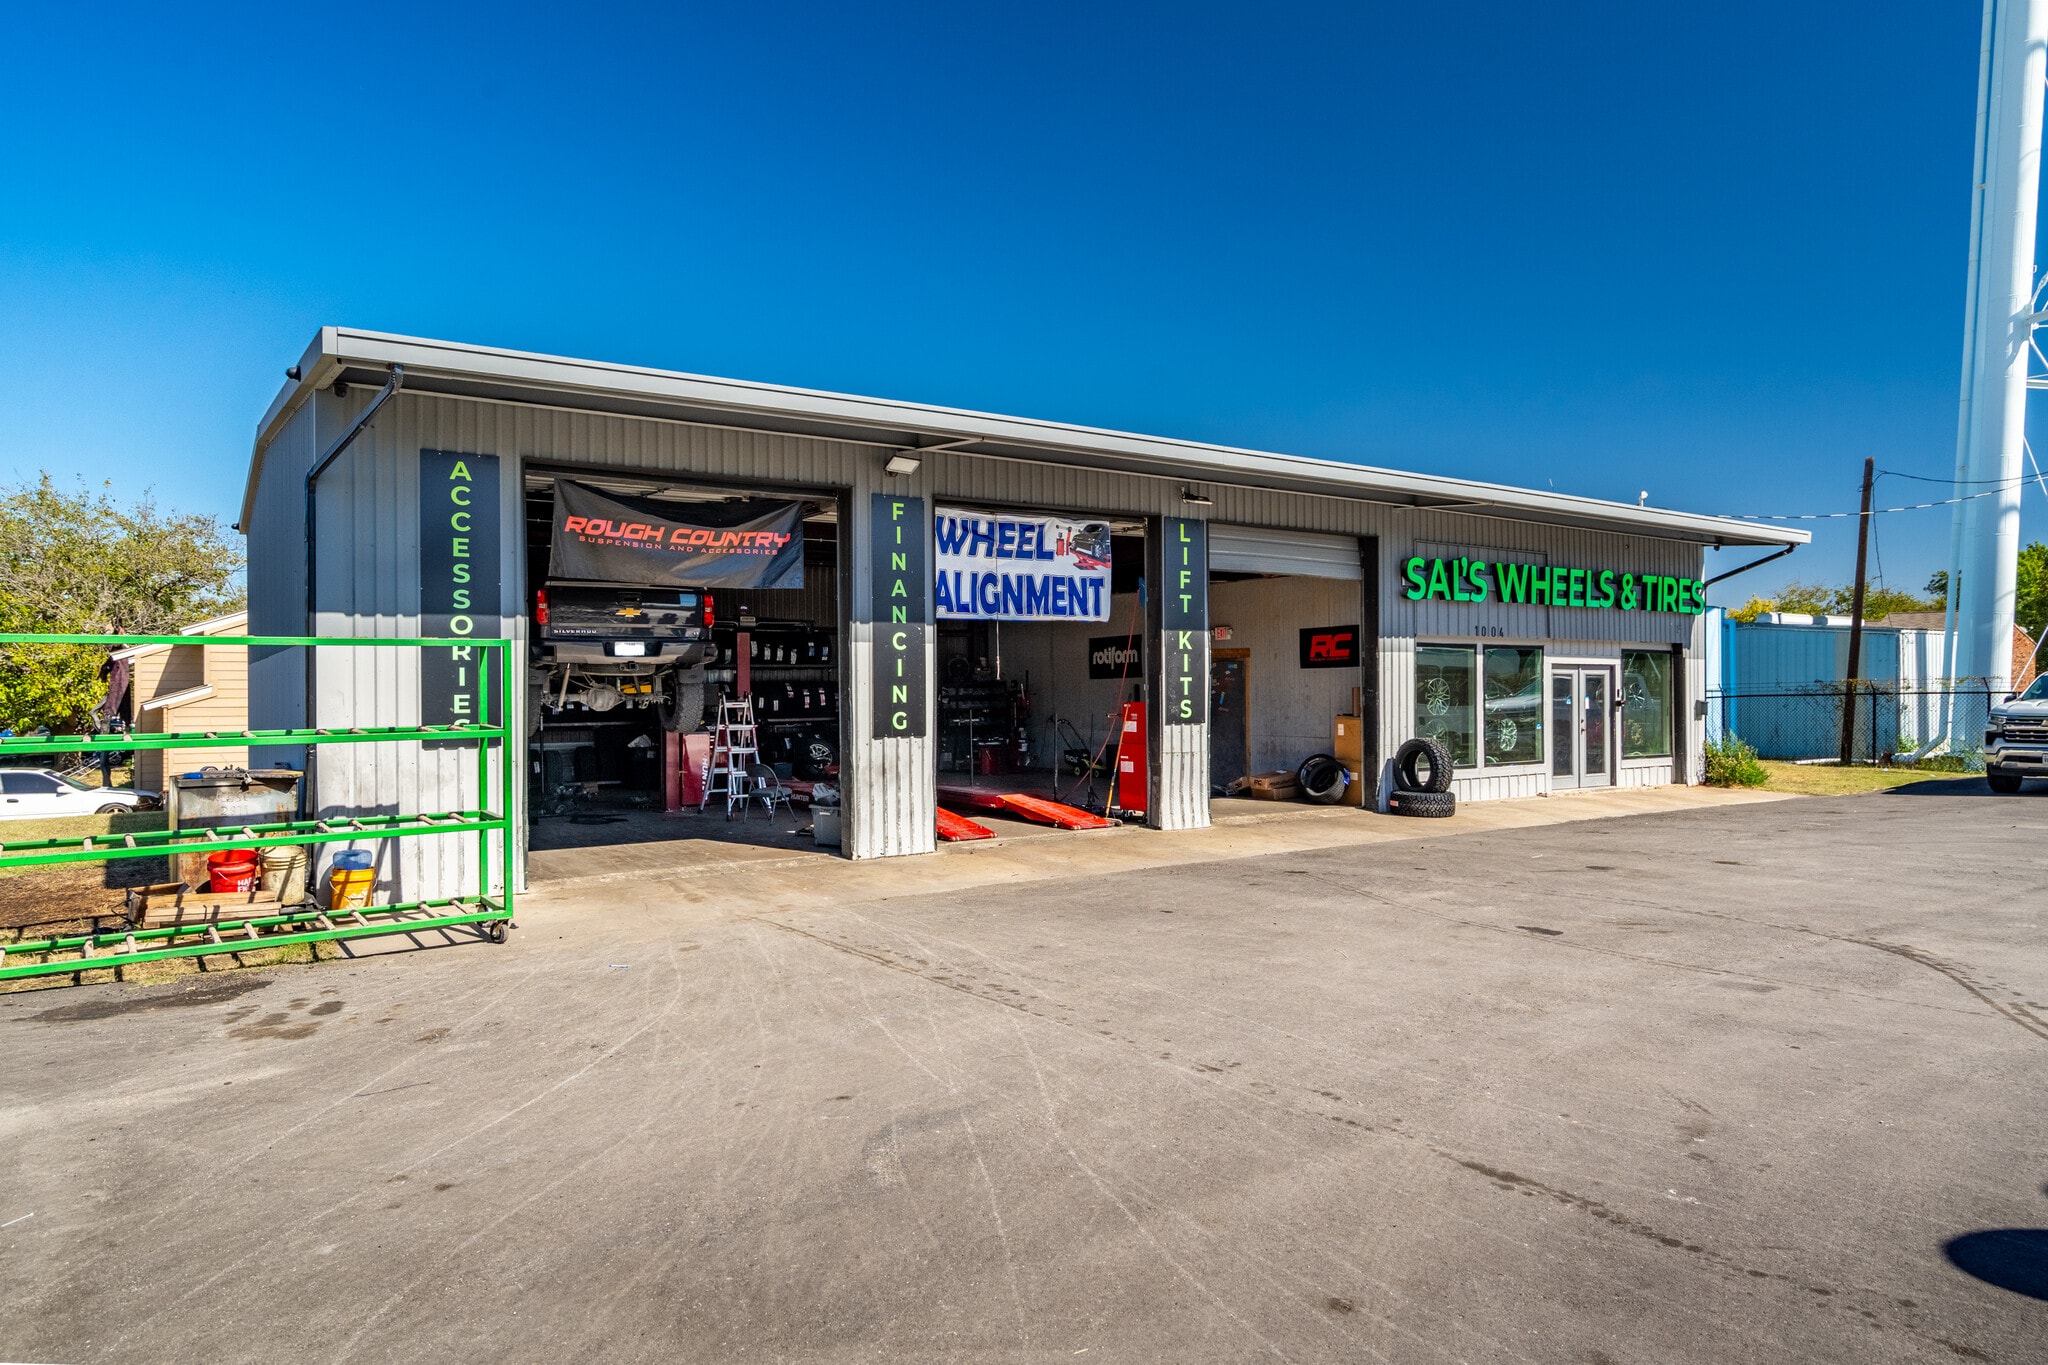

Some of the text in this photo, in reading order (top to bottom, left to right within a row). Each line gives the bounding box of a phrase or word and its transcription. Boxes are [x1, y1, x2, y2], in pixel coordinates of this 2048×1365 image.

[564, 515, 791, 548] ROUGH COUNTRY
[579, 535, 778, 556] SUSPENSION AND ACCESSORIES
[936, 515, 1054, 560] WHEEL
[936, 569, 1104, 617] ALIGNMENT
[1406, 556, 1705, 616] SAL'S WHEELS & TIRES
[891, 502, 908, 730] FINANCING
[1178, 523, 1193, 719] LIFT KITS
[1474, 625, 1504, 638] 1004
[1092, 647, 1138, 669] rotiform
[1310, 633, 1353, 657] RC
